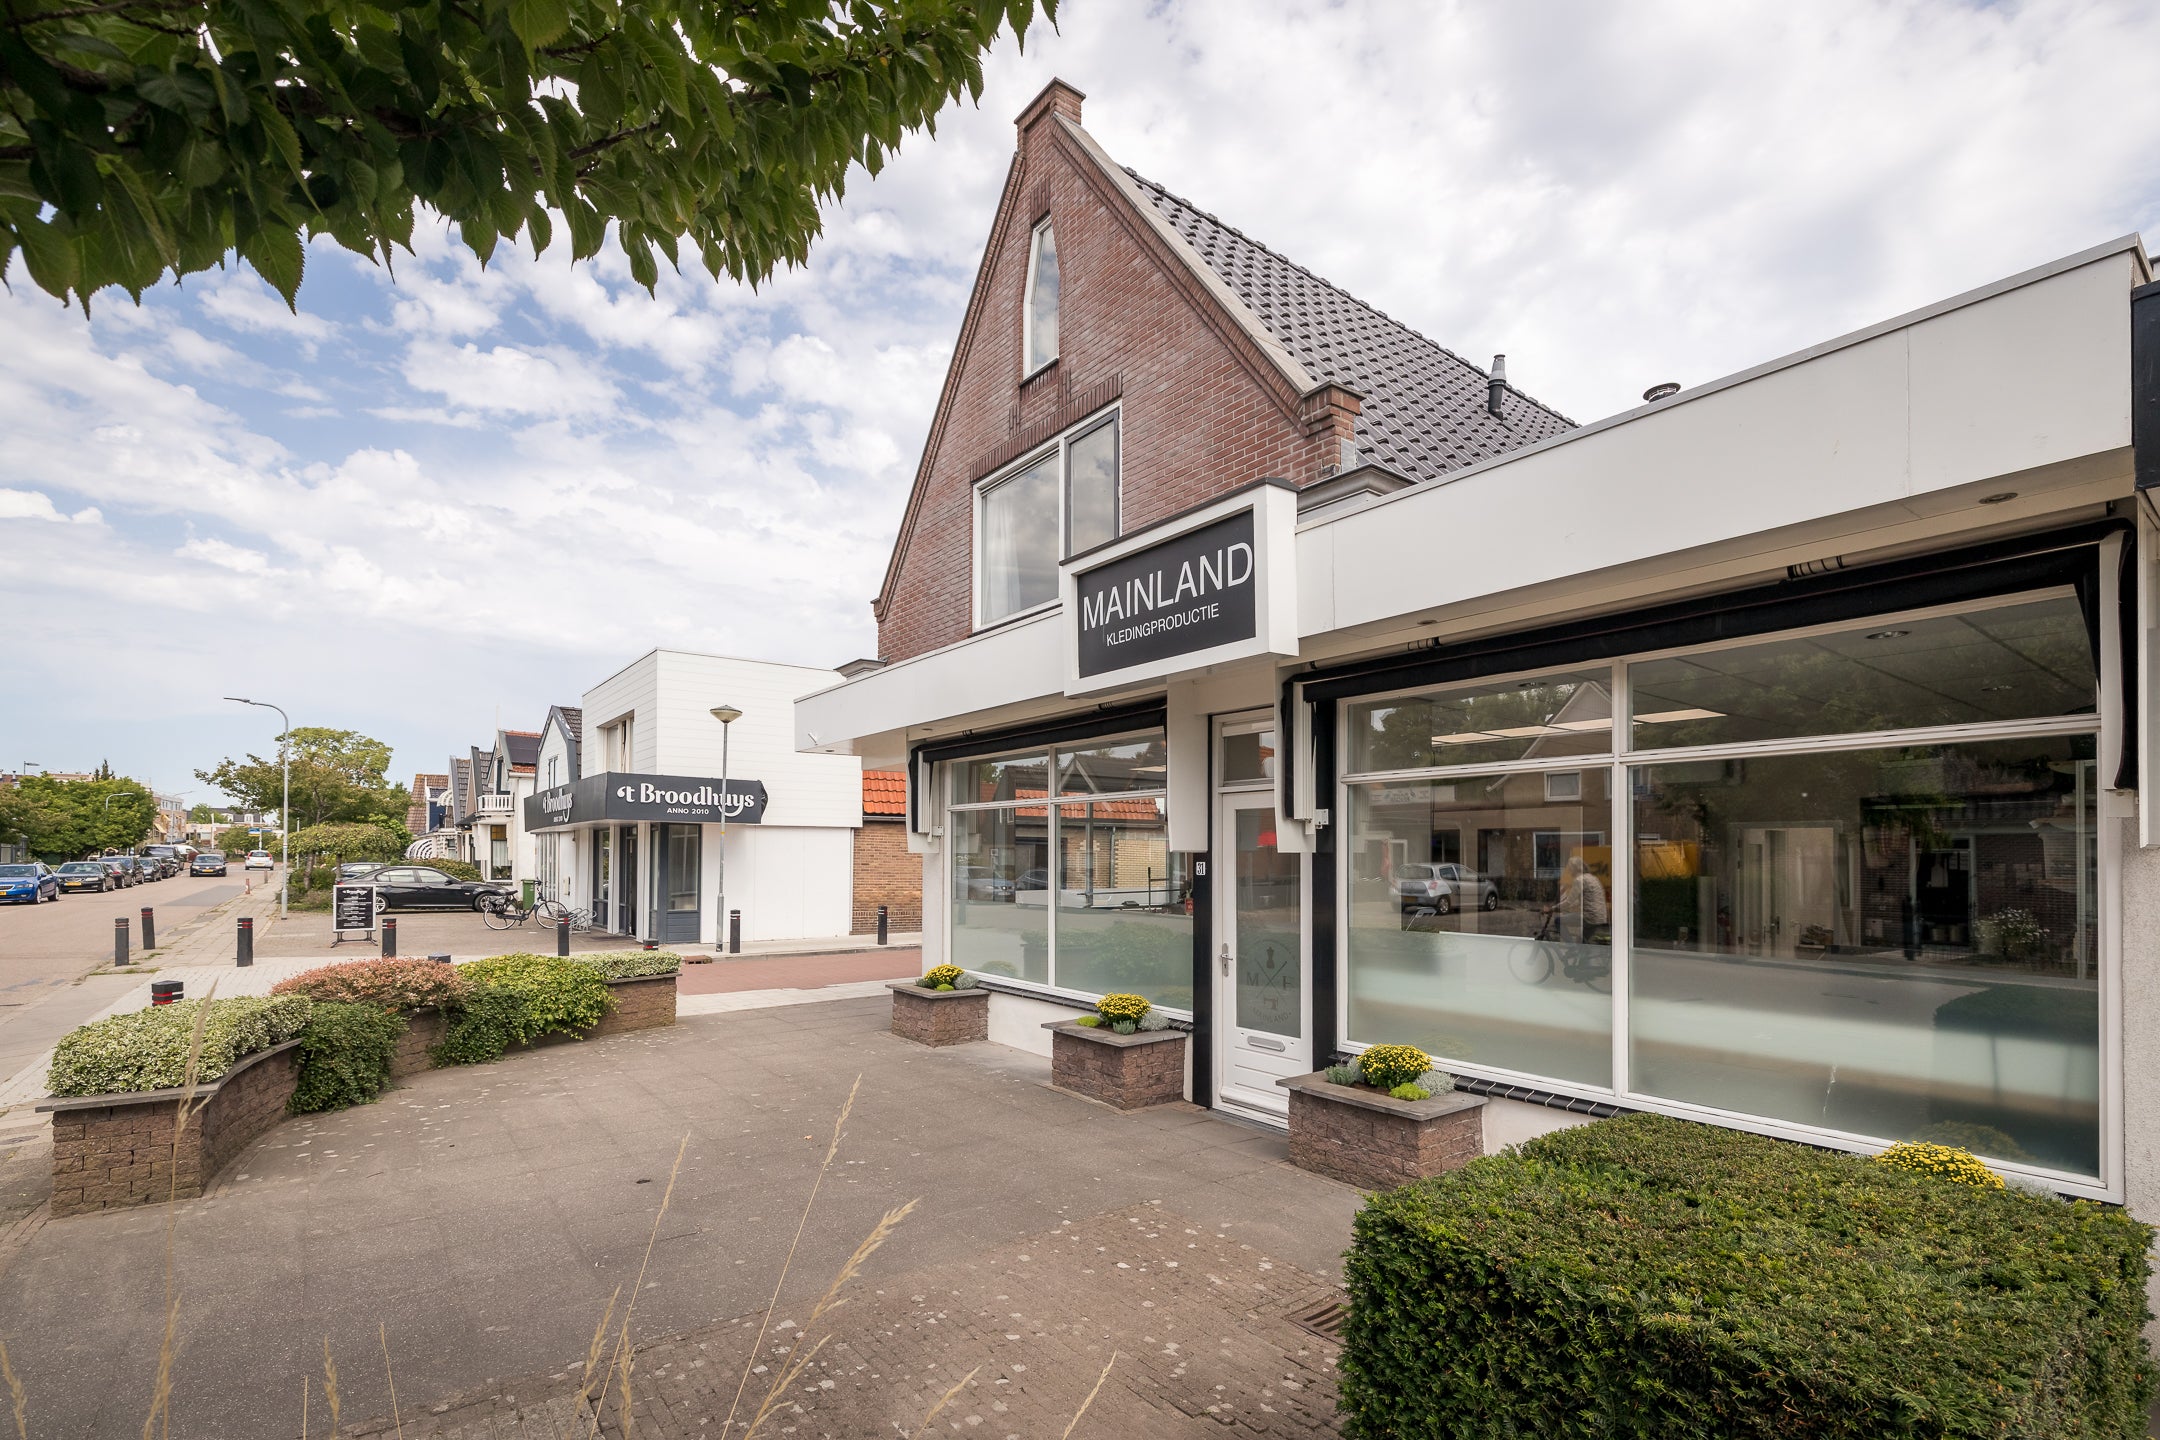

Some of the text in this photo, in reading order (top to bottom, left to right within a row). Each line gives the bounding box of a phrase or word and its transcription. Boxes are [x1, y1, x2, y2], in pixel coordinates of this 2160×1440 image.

[1083, 542, 1253, 631] MAINLAND
[1106, 603, 1219, 646] KLEDINGPRODUCTIE
[640, 783, 755, 817] Broodhuys
[1197, 862, 1205, 875] 31
